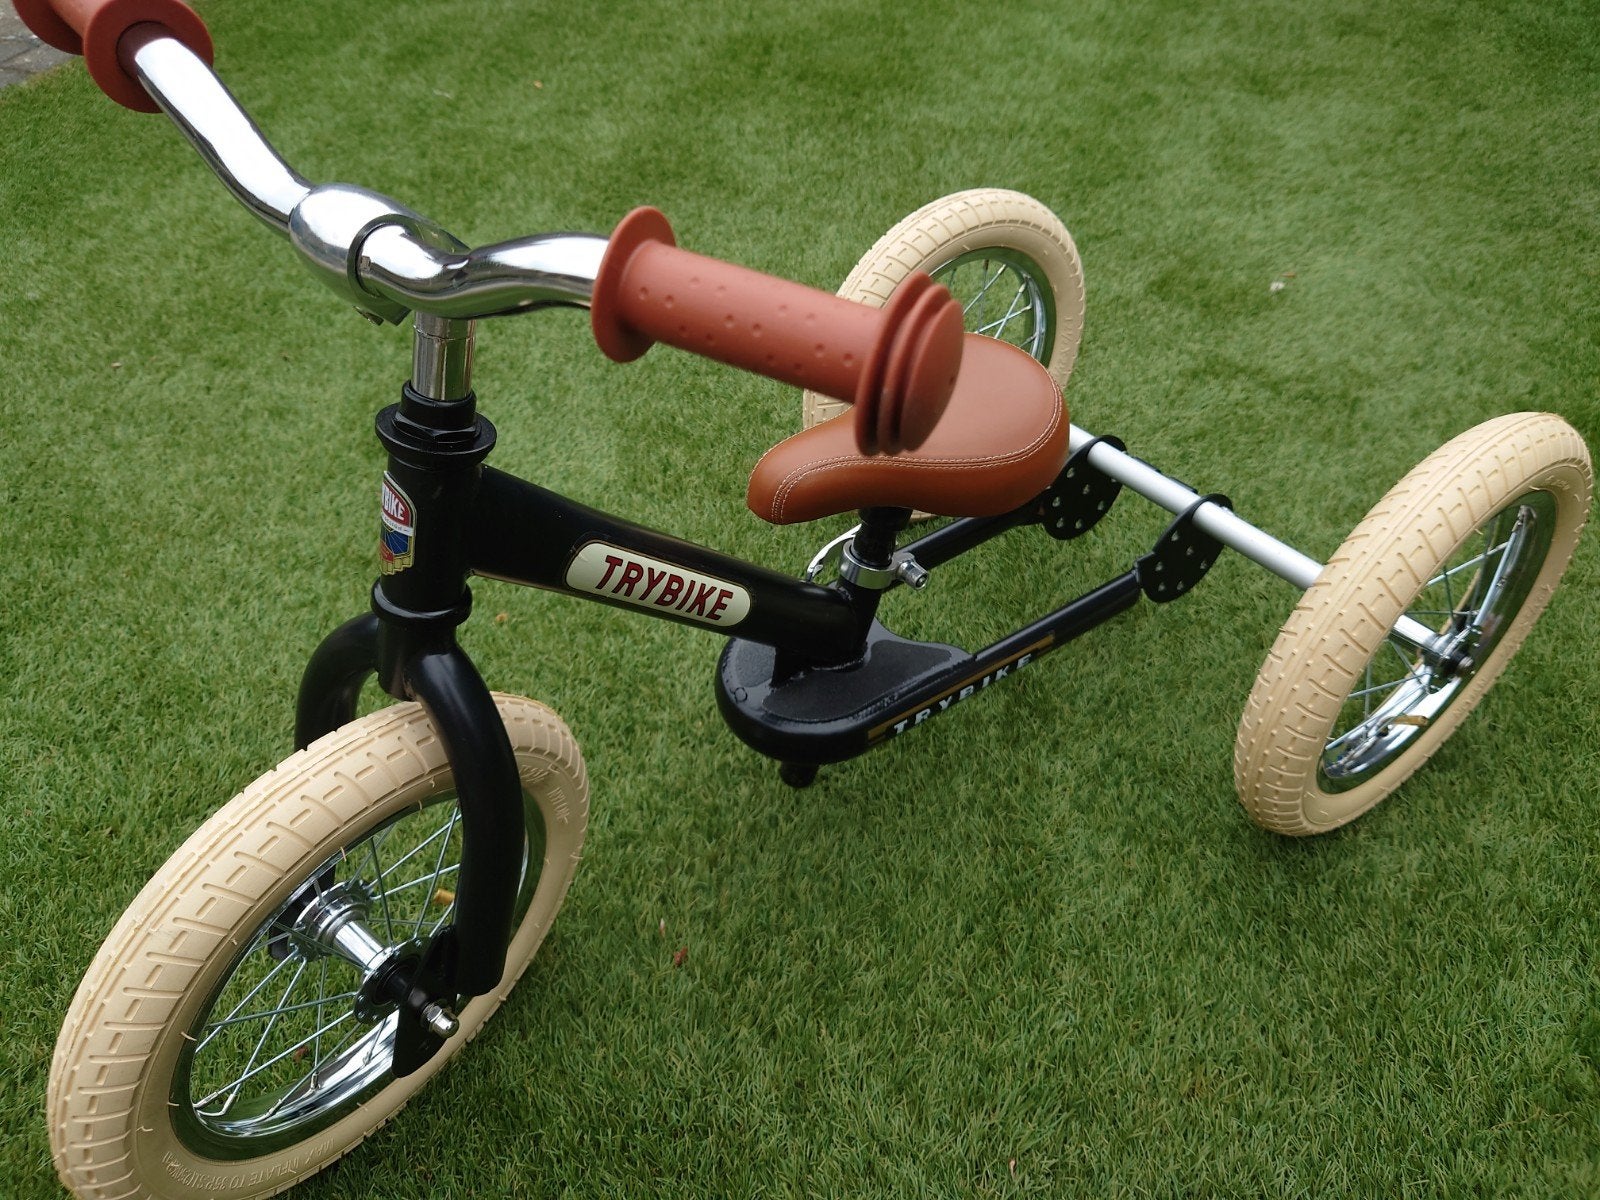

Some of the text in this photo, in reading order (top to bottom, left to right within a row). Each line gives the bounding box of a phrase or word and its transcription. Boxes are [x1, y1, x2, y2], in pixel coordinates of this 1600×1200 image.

[382, 482, 405, 521] BIKE
[595, 554, 734, 621] TRYBIKE
[893, 653, 1032, 734] TRYBIKE
